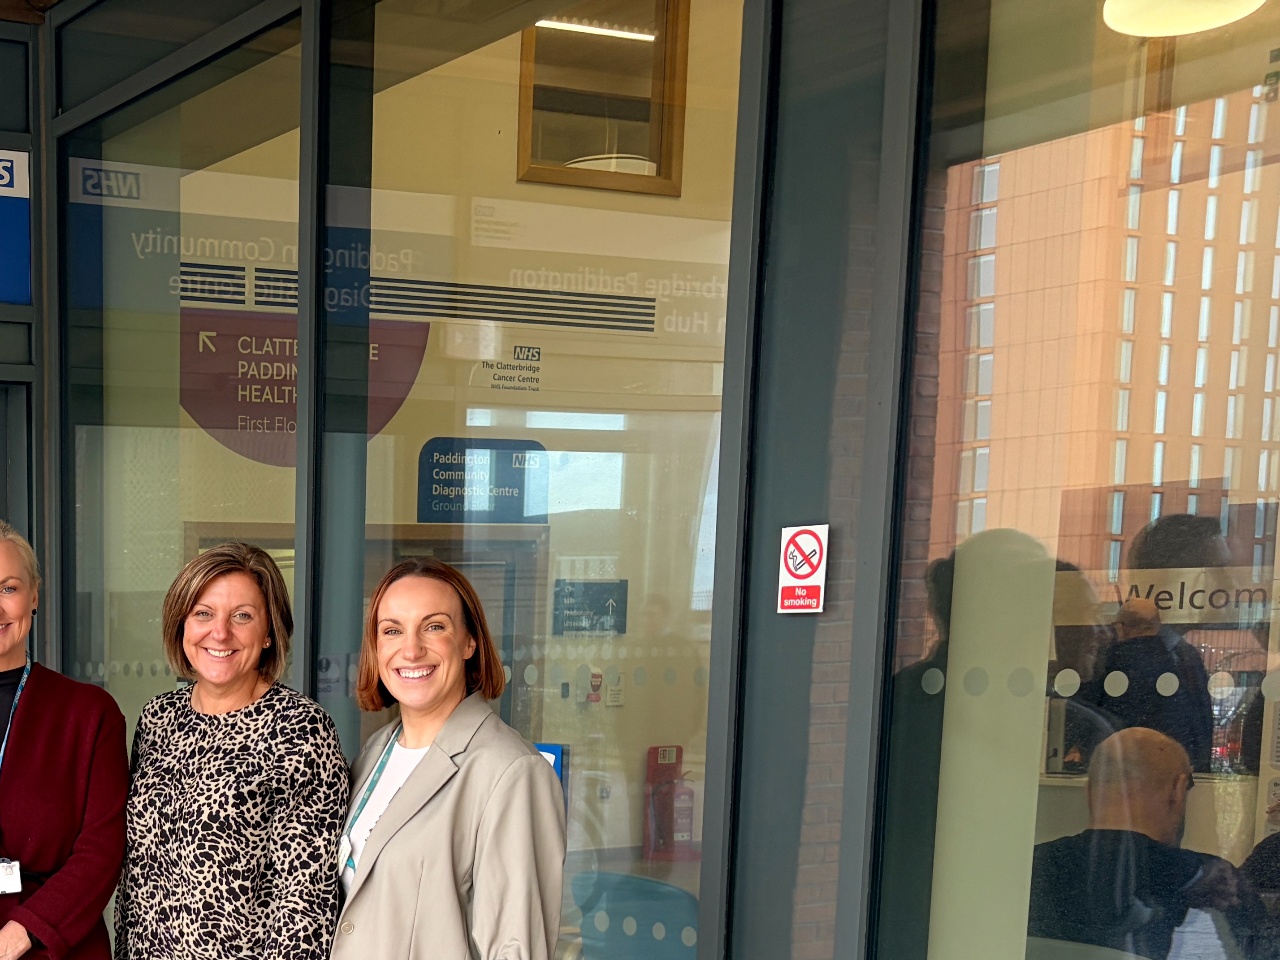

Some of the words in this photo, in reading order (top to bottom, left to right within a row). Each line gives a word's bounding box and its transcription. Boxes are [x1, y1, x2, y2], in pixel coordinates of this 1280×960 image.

[514, 347, 539, 360] NHS
[482, 361, 494, 369] The
[496, 362, 540, 373] Clatterbridge
[493, 374, 516, 382] Cancer
[518, 375, 540, 383] Centre
[238, 416, 271, 433] First
[434, 453, 489, 466] Paddington
[514, 454, 539, 466] NHS
[433, 469, 489, 482] Community
[432, 484, 485, 498] Diagnostic
[488, 486, 519, 496] Centre
[796, 588, 806, 596] No
[784, 598, 817, 608] smoking
